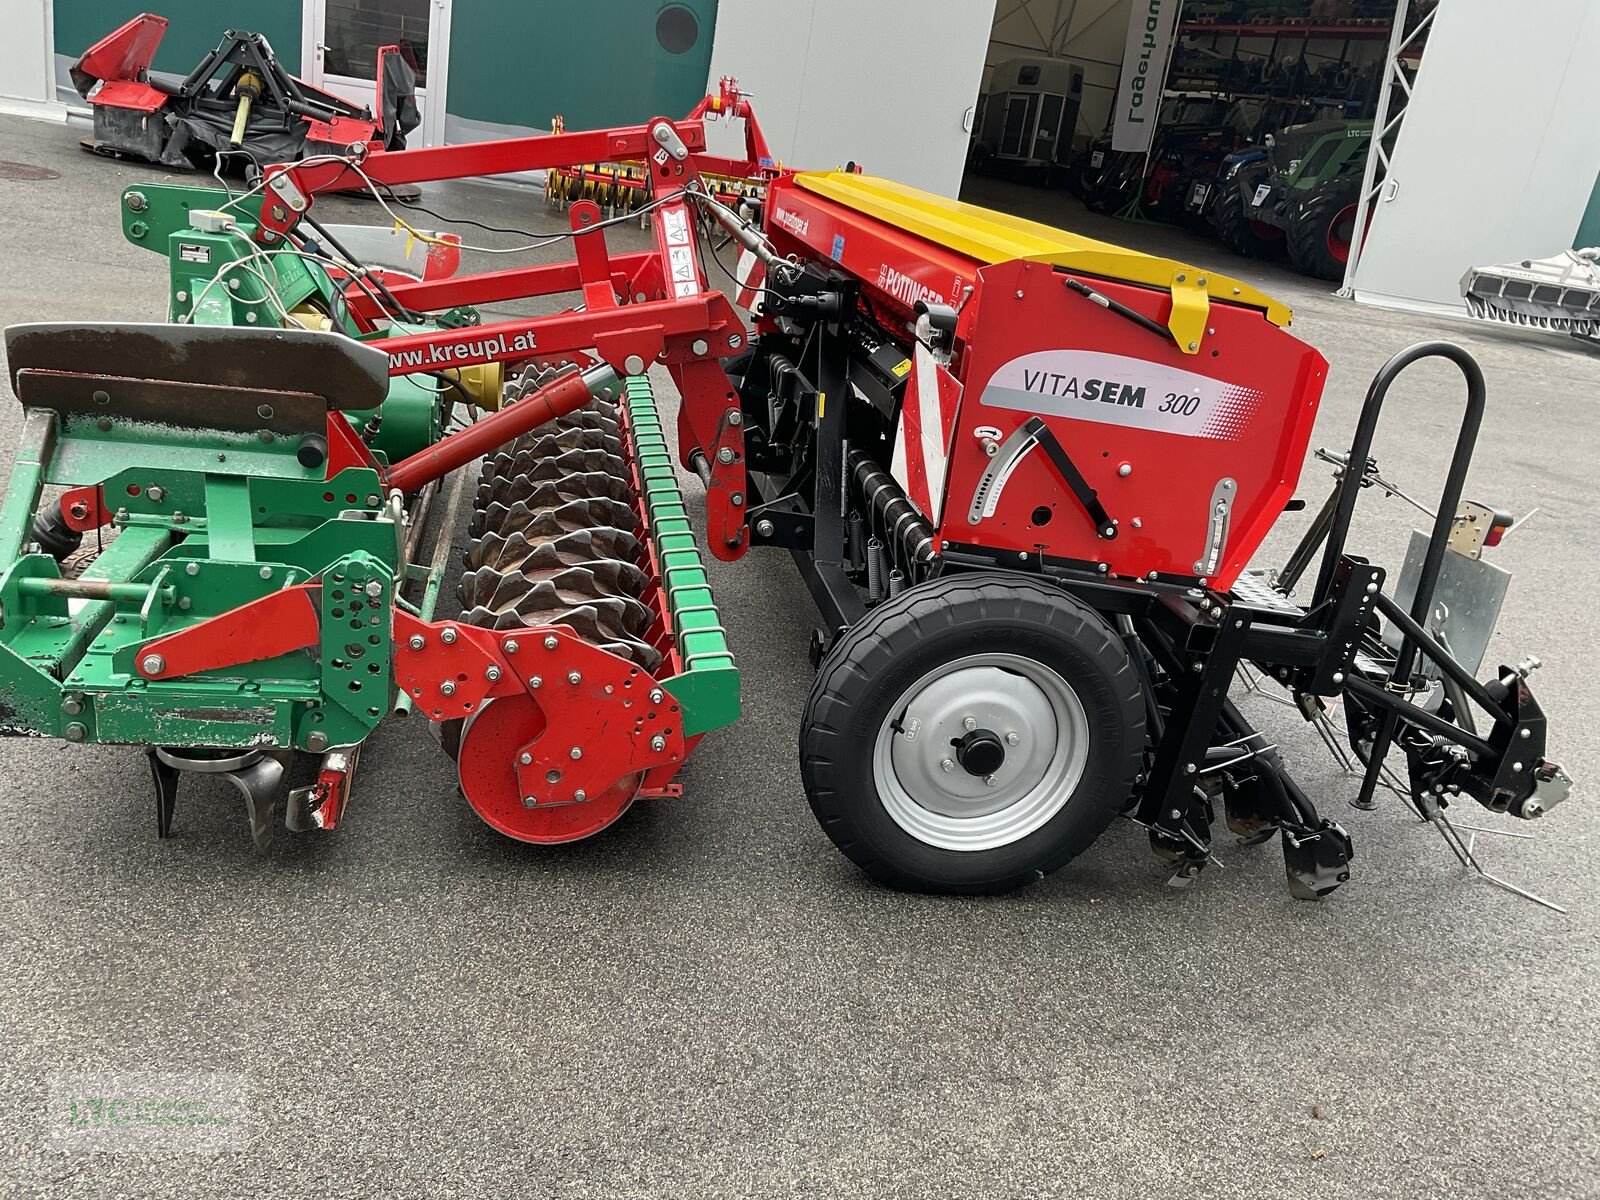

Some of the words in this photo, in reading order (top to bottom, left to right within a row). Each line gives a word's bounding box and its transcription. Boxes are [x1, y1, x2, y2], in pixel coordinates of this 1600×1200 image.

[388, 330, 537, 369] ww.kreupl.at
[1024, 369, 1147, 408] VITASEM
[1158, 392, 1201, 416] 300
